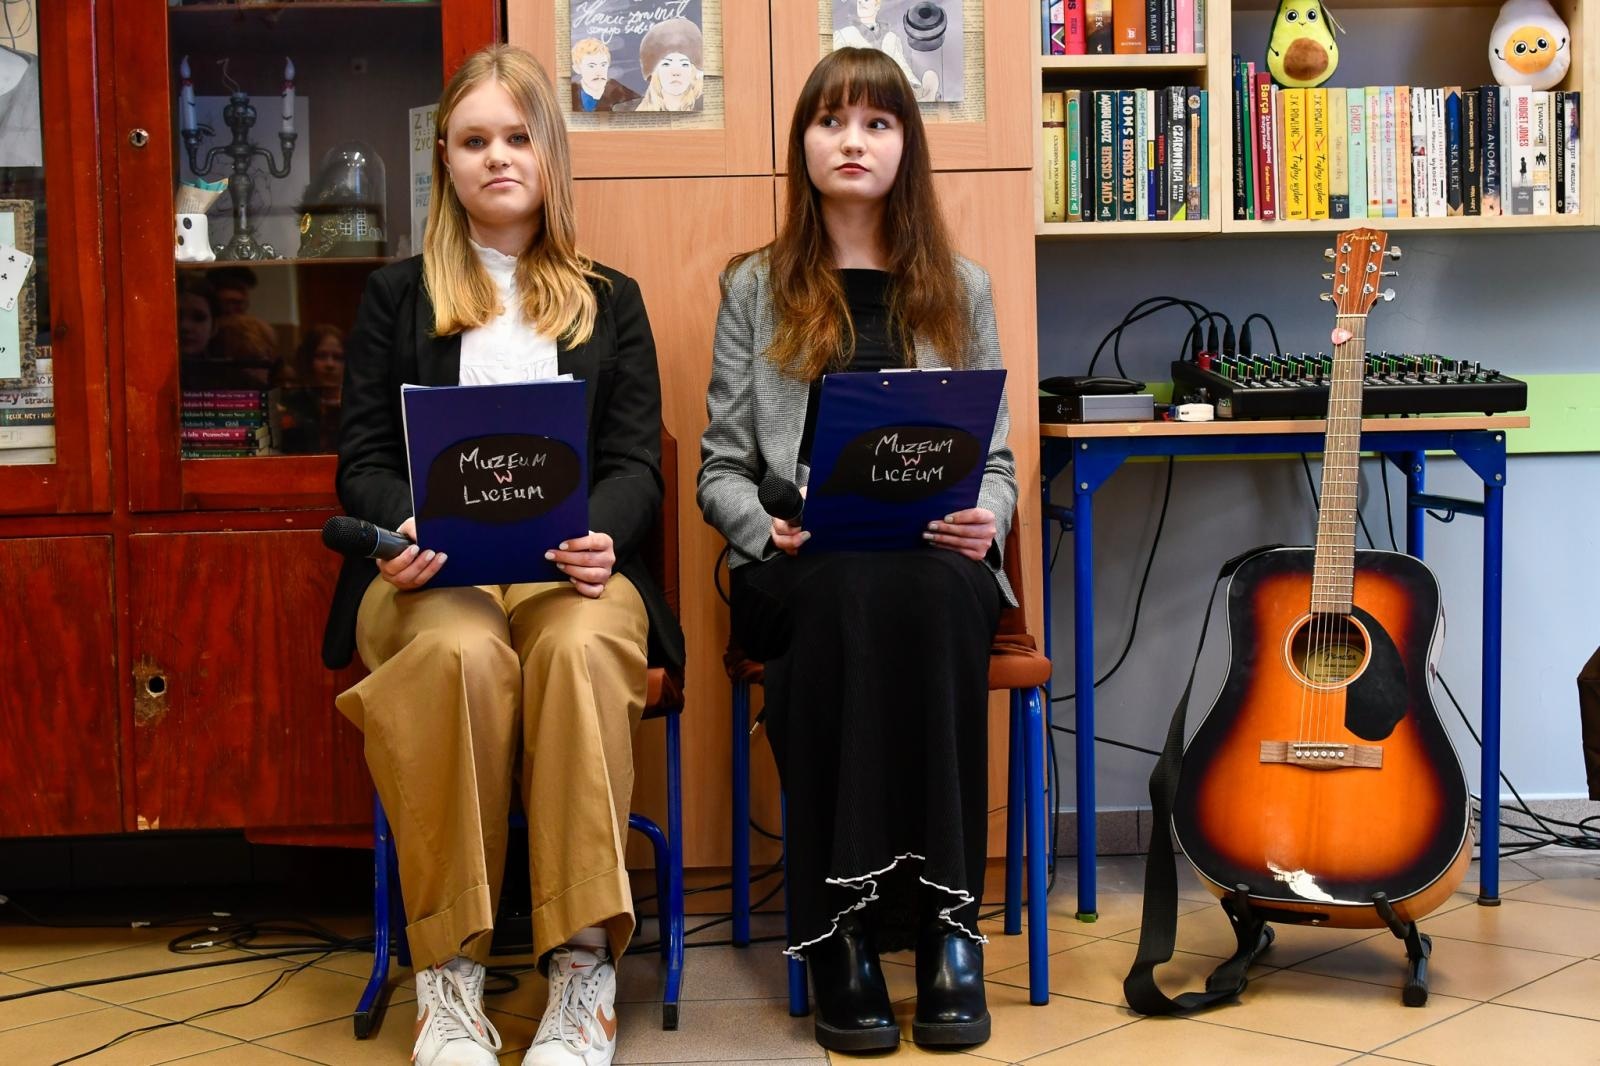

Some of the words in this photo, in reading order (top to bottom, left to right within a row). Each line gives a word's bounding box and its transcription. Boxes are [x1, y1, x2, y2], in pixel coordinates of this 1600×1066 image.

[1260, 84, 1270, 114] Barça
[1518, 96, 1528, 124] BRIDGET
[1101, 119, 1112, 143] ZŁOTO
[1122, 96, 1134, 136] SMOK
[1519, 125, 1529, 147] JONES
[1101, 146, 1113, 180] CUSSLER
[1122, 139, 1134, 177] CUSSLER
[1172, 125, 1184, 182] CZAROWNICA
[1487, 134, 1496, 195] ANOMALIA
[1101, 181, 1113, 204] CLIVE
[1122, 178, 1134, 203] CLIVE
